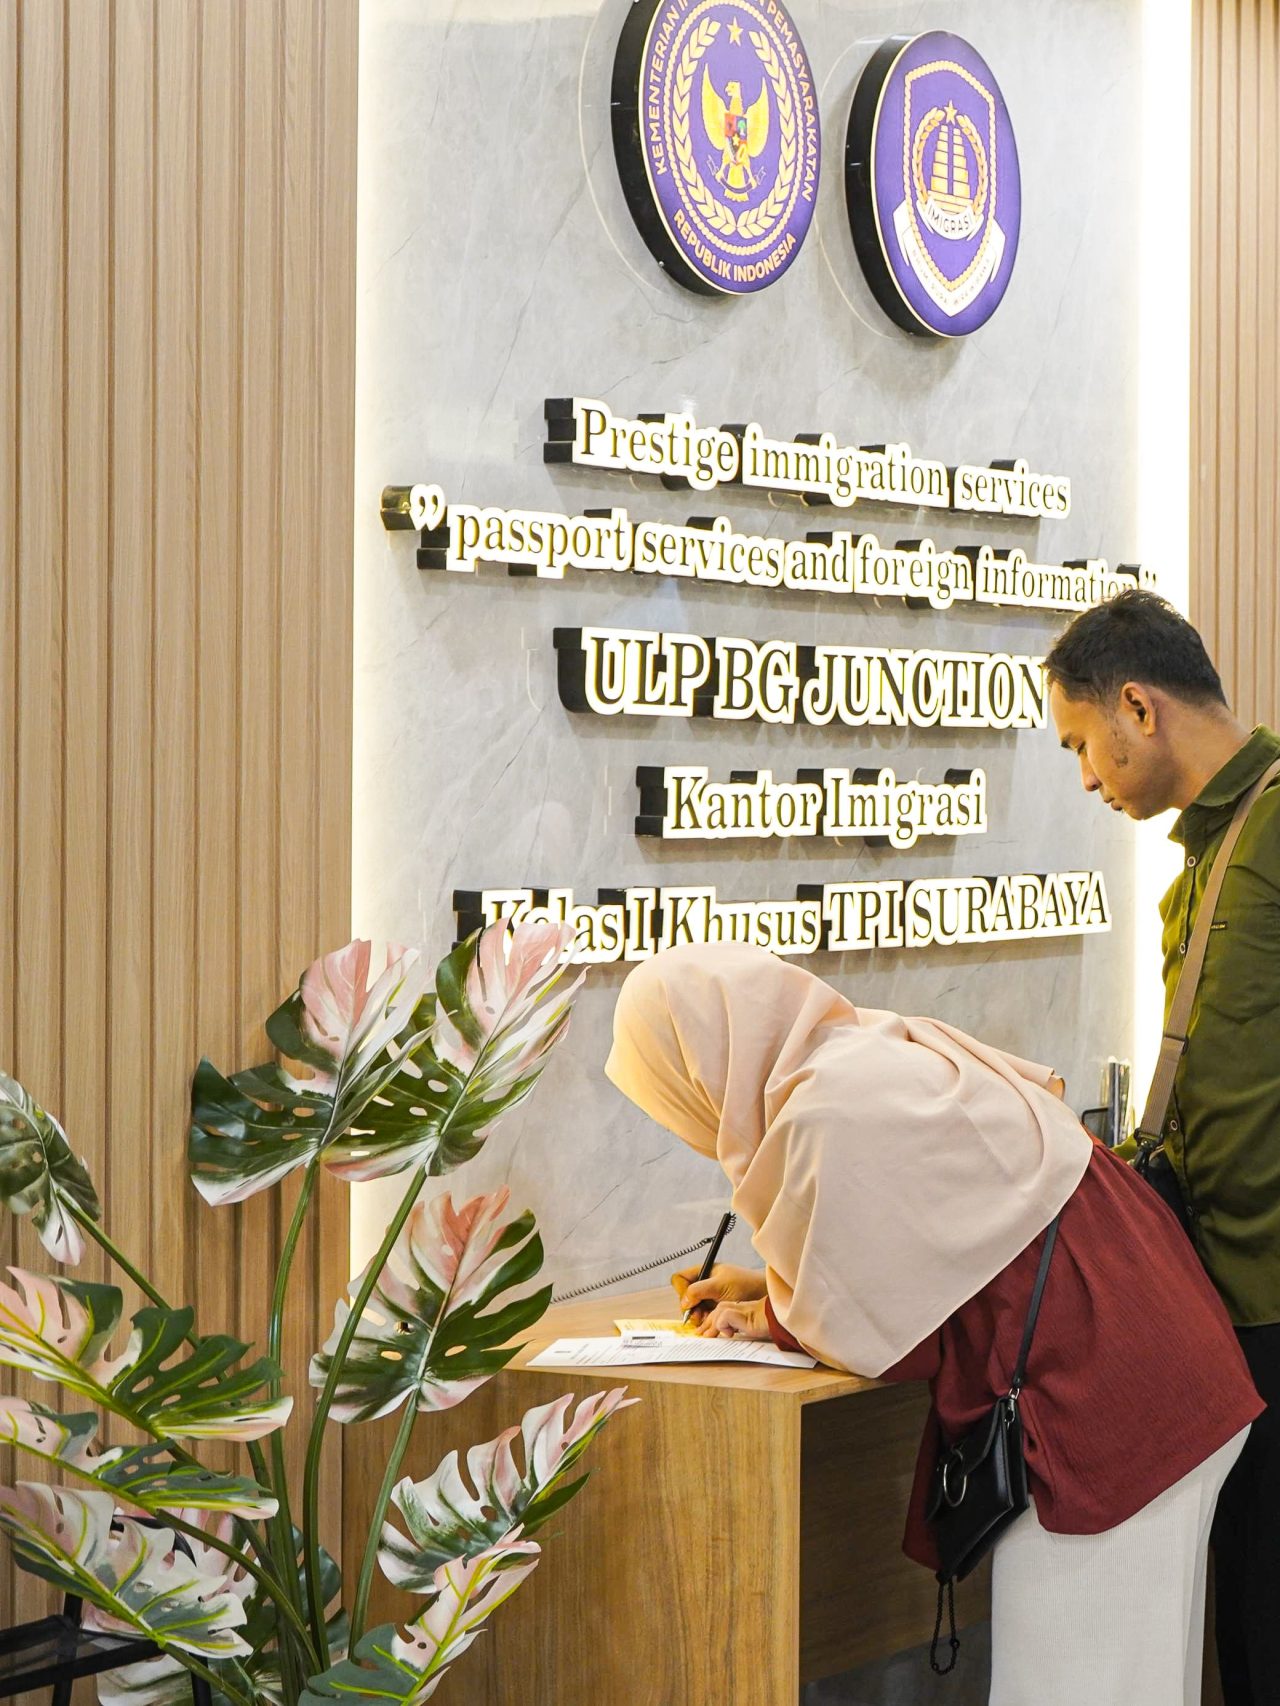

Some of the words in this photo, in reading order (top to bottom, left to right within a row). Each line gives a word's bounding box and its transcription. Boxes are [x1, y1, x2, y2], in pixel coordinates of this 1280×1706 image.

[649, 5, 680, 175] KEMENTERIAN
[767, 1, 817, 202] PEMASYARAKATAN
[673, 208, 731, 281] REPUBLIK
[733, 232, 797, 283] INDONESIA
[927, 203, 975, 234] IMIGRASI
[580, 407, 734, 481] Prestige
[750, 431, 944, 498] immigration
[960, 466, 1068, 512] services
[641, 522, 780, 579] services
[790, 539, 849, 583] and
[860, 541, 974, 600] foreign
[590, 636, 705, 707] ULP
[719, 646, 794, 714] BG
[810, 653, 1048, 720] JUNCTION
[671, 776, 817, 830] Kantor
[830, 776, 983, 841] Imigrasi
[632, 896, 649, 951] I
[668, 895, 817, 949] Khusus
[830, 889, 899, 942] TPI
[912, 879, 1108, 939] SURABAYA
